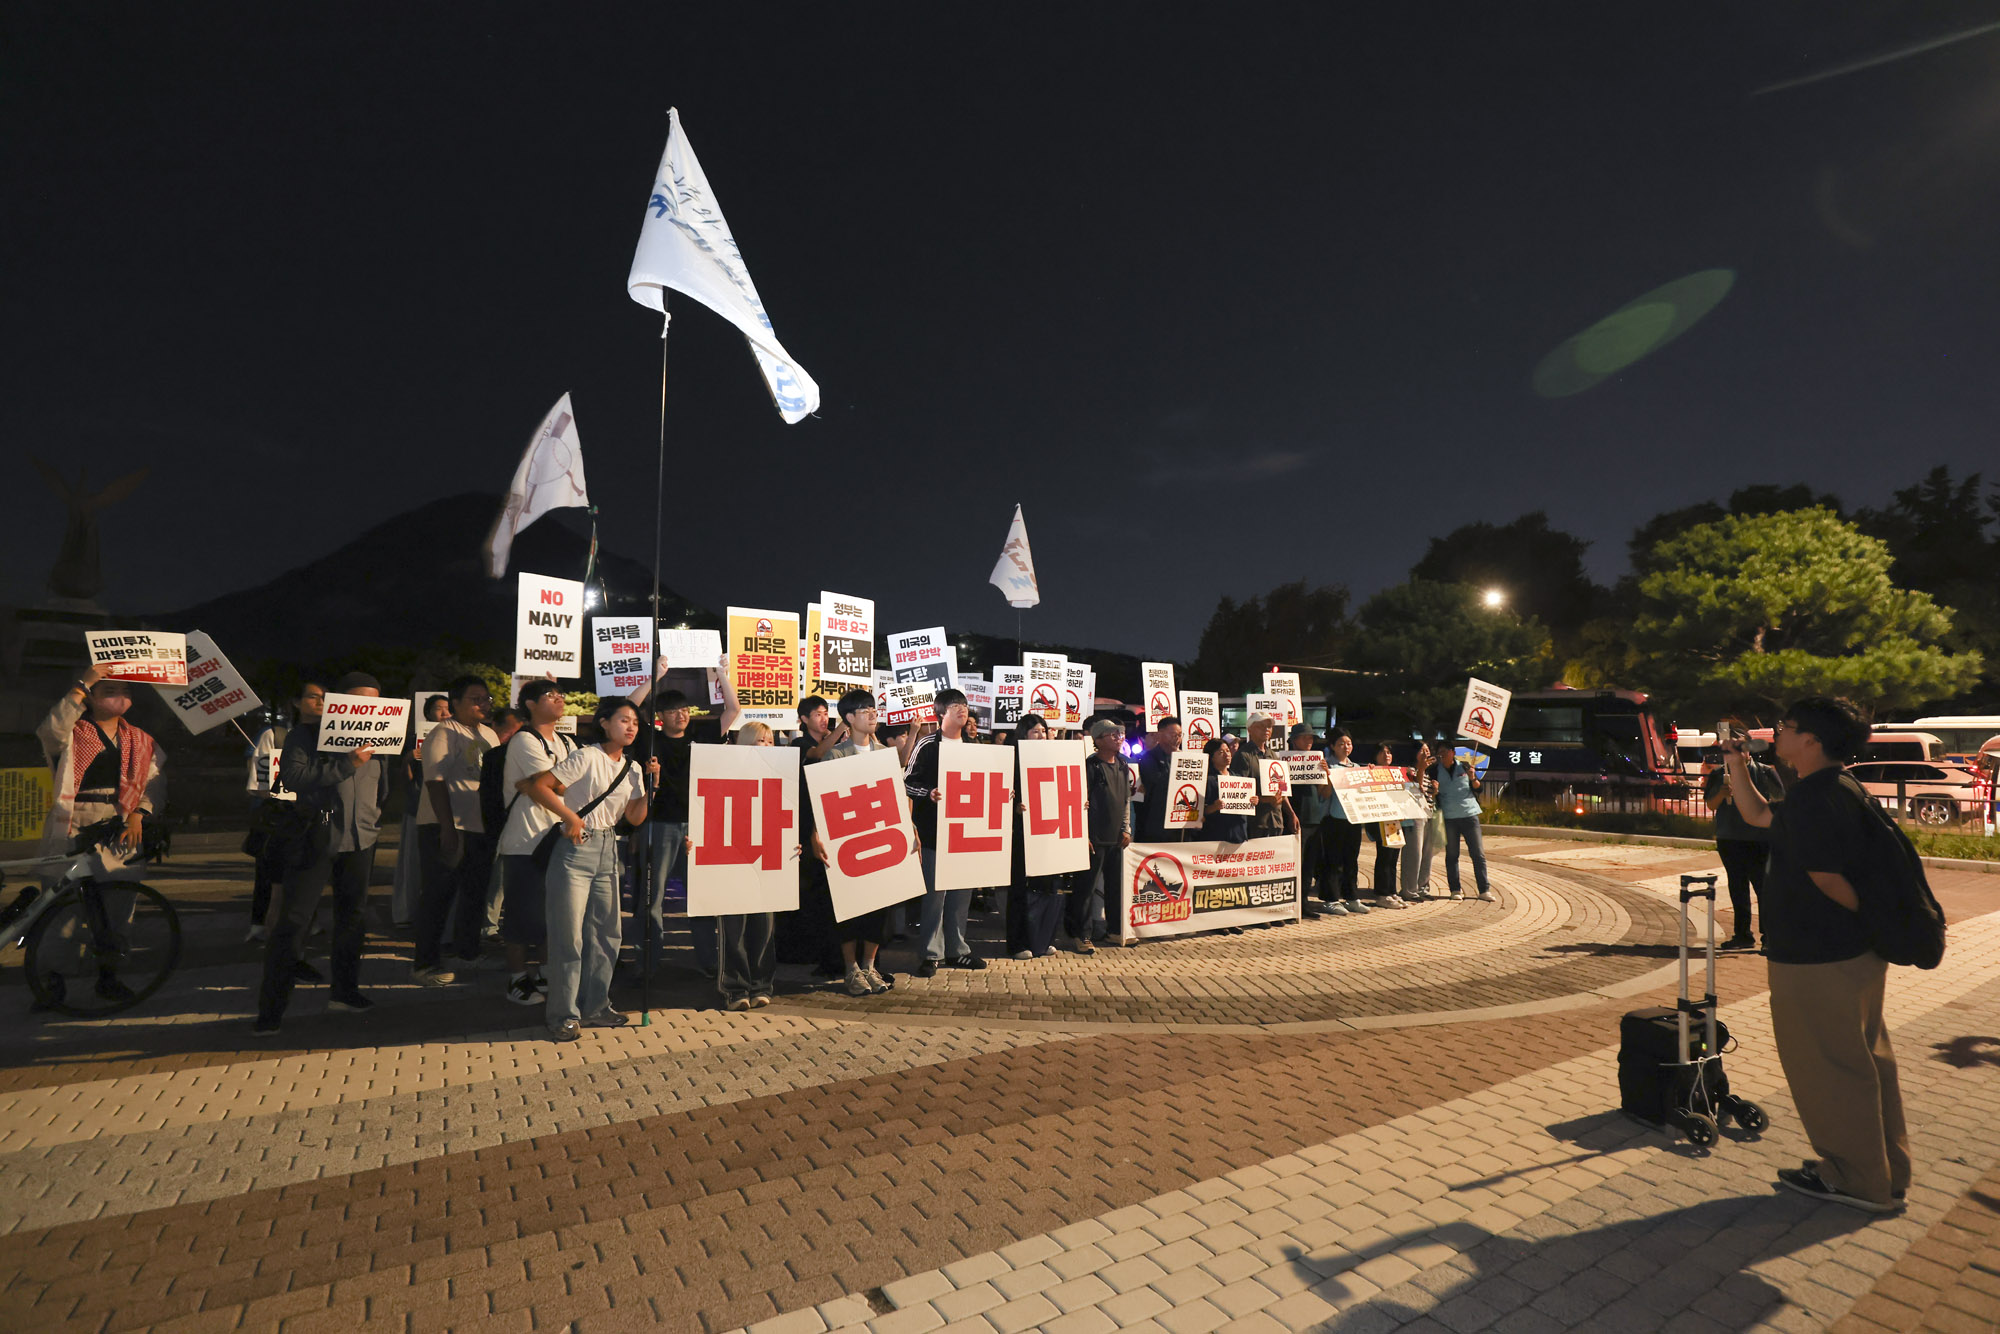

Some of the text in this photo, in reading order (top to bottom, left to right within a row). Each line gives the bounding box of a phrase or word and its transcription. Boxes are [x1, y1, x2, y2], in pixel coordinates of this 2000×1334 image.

[541, 589, 563, 605] NO
[834, 602, 862, 618] 정부는
[529, 610, 573, 628] NAVY
[827, 617, 868, 634] 파병 요구
[544, 633, 558, 645] TO
[596, 624, 640, 642] 침략을
[92, 636, 157, 648] 대미투자,
[611, 643, 649, 655] 멈춰라!
[744, 637, 786, 654] 미국은
[827, 640, 854, 656] 거부
[899, 635, 931, 649] 미국의
[95, 648, 153, 661] 파병압박
[737, 654, 793, 671] 호르무즈
[896, 646, 941, 664] 파병 압박
[111, 661, 186, 678] 종외교 규탄!
[187, 657, 222, 682] 춰라!
[598, 657, 643, 676] 전쟁을
[838, 657, 869, 673] 하라!
[737, 671, 793, 688] 파병압박
[174, 676, 227, 711] 전쟁을
[737, 689, 793, 706] 중단하라
[890, 685, 914, 698] 국민을
[998, 685, 1024, 694] 파병 요
[200, 688, 247, 715] 멈춰라!
[327, 703, 403, 716] DO NOT JOIN
[998, 698, 1020, 710] 거부
[1255, 701, 1278, 710] 미국의
[325, 720, 390, 732] A WAR OF
[324, 736, 403, 748] AGGRESSION!
[1266, 737, 1283, 750] 다!
[1220, 781, 1229, 789] DO
[1026, 765, 1083, 840] 대
[945, 771, 1010, 854] 반
[695, 778, 793, 871] 파
[820, 777, 908, 878] 병
[1192, 850, 1275, 865] 미국은 침략전쟁 중단하라!
[1192, 862, 1296, 880] 정부는 파병압박 단호히 거부하라!
[1132, 893, 1162, 904] 호르무즈
[1194, 881, 1295, 909] 파병반대 평화행진
[1133, 900, 1190, 924] 파병반대
